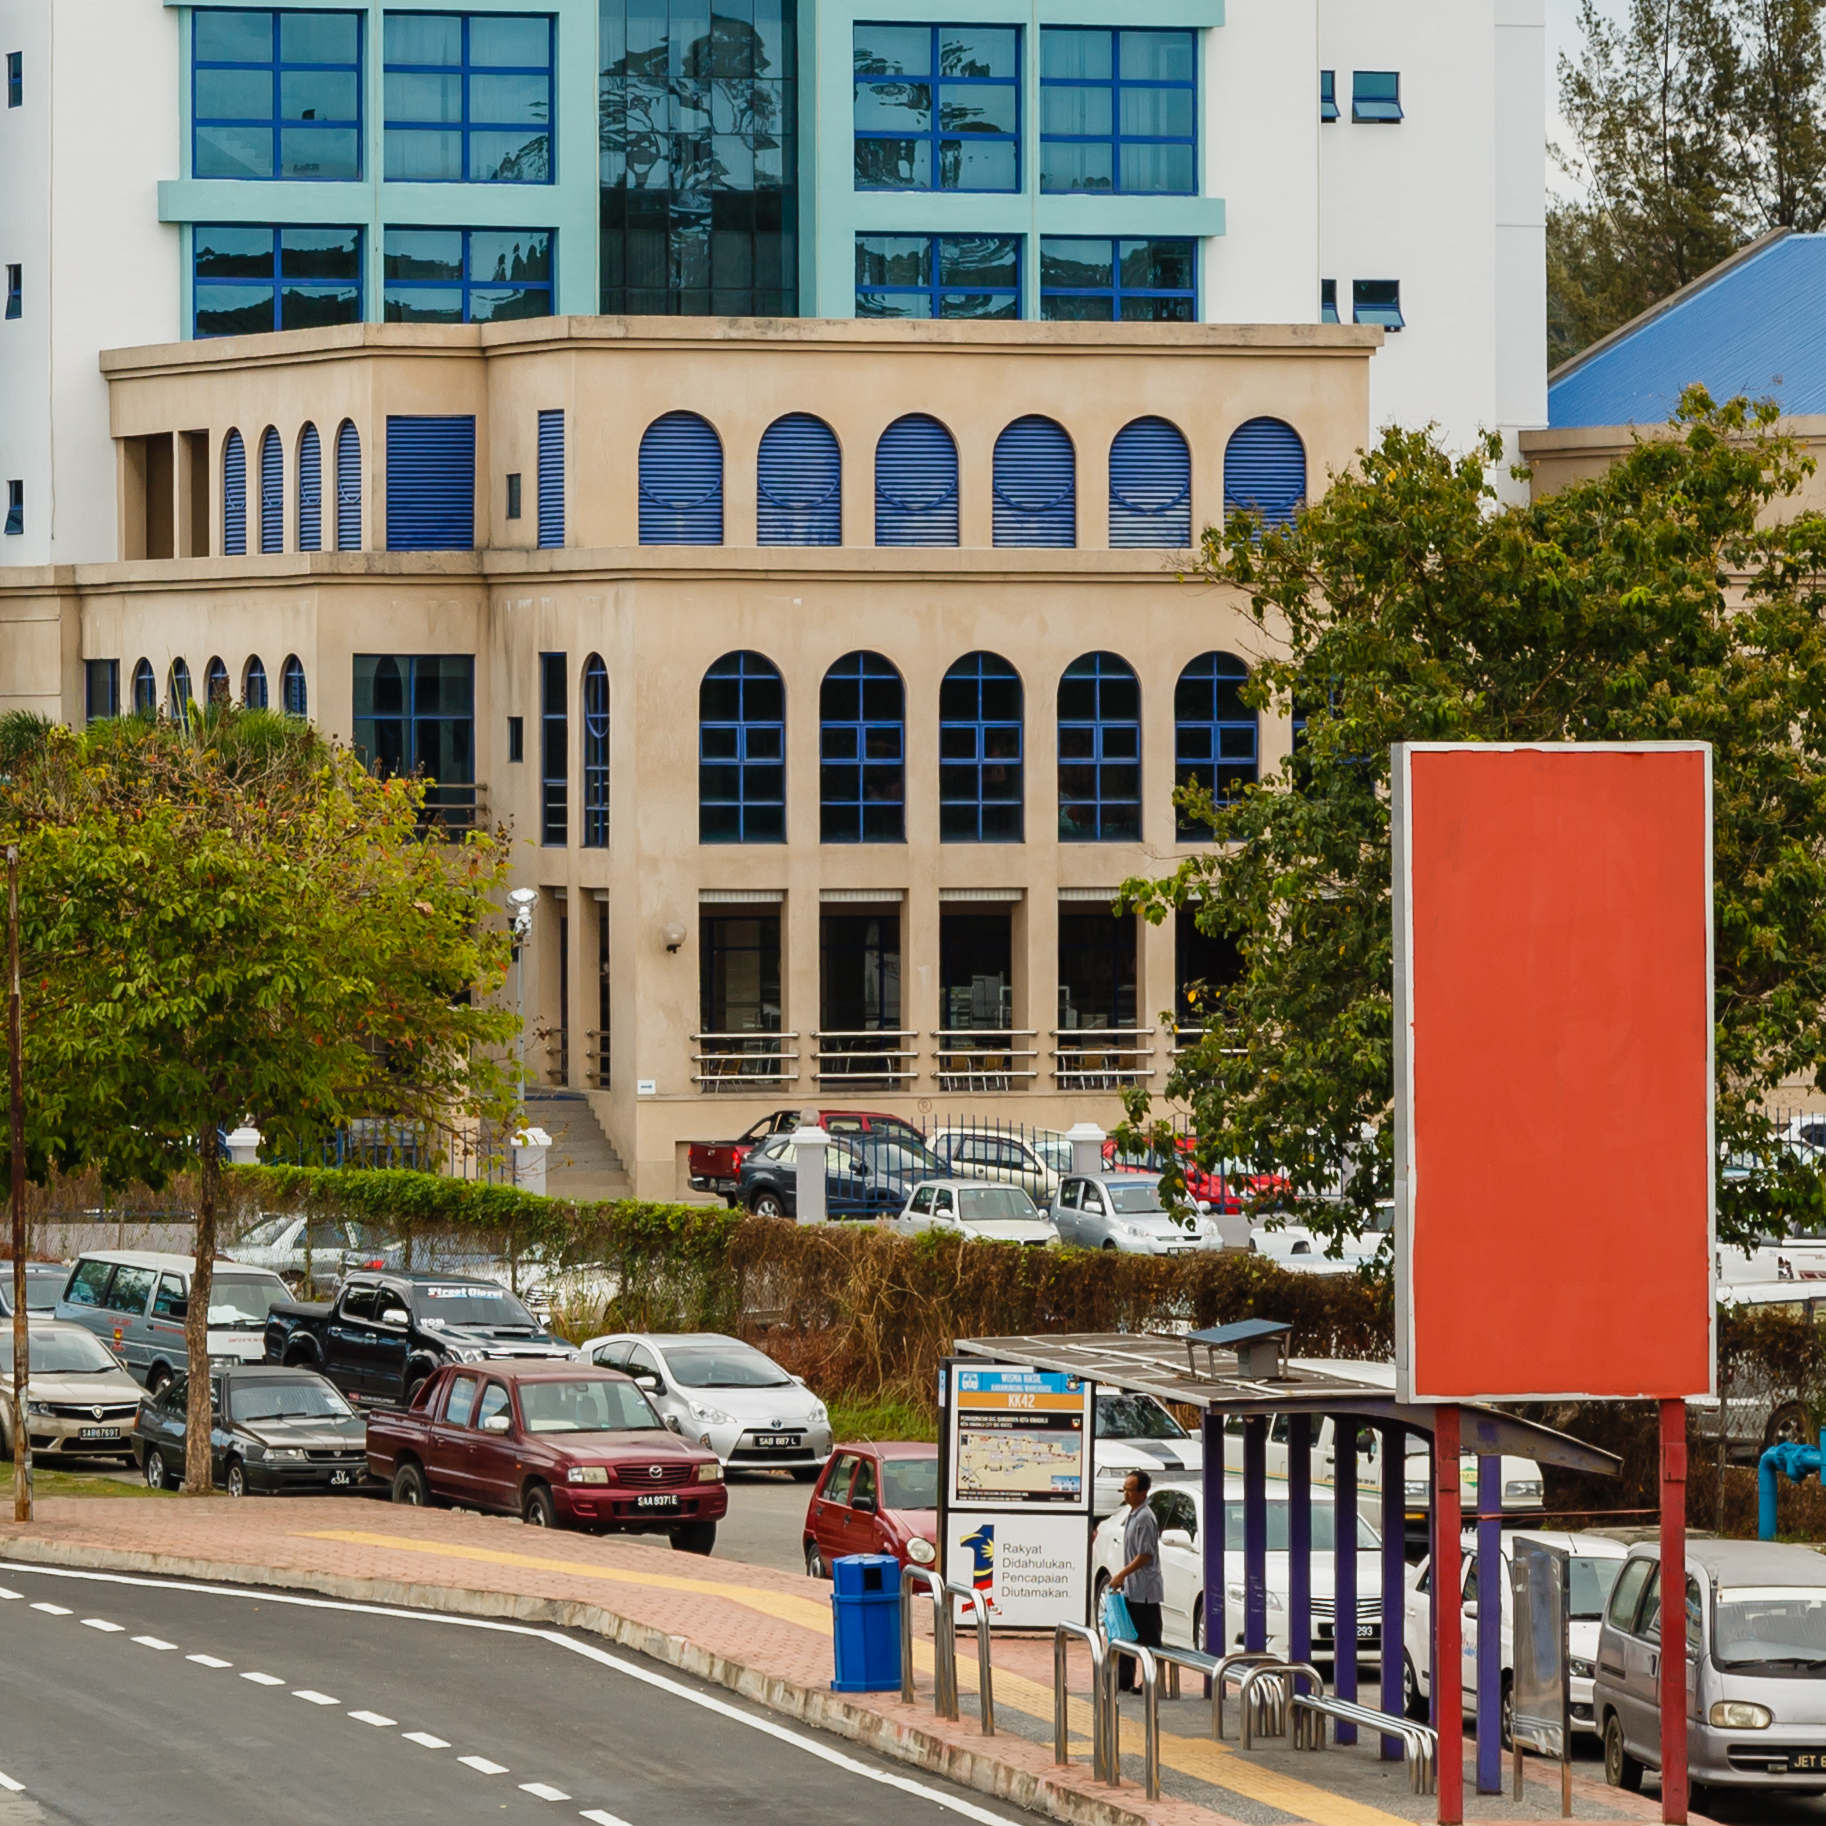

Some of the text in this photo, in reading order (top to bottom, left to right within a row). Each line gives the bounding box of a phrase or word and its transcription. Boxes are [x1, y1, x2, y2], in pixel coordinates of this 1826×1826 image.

[1008, 1393, 1035, 1408] KK42
[1002, 1543, 1042, 1556] Rakyat
[1002, 1557, 1075, 1571] Didahulukan,
[1002, 1571, 1068, 1585] Pencapaian
[1001, 1586, 1071, 1599] Diutamakan.
[1794, 1755, 1816, 1768] JET
